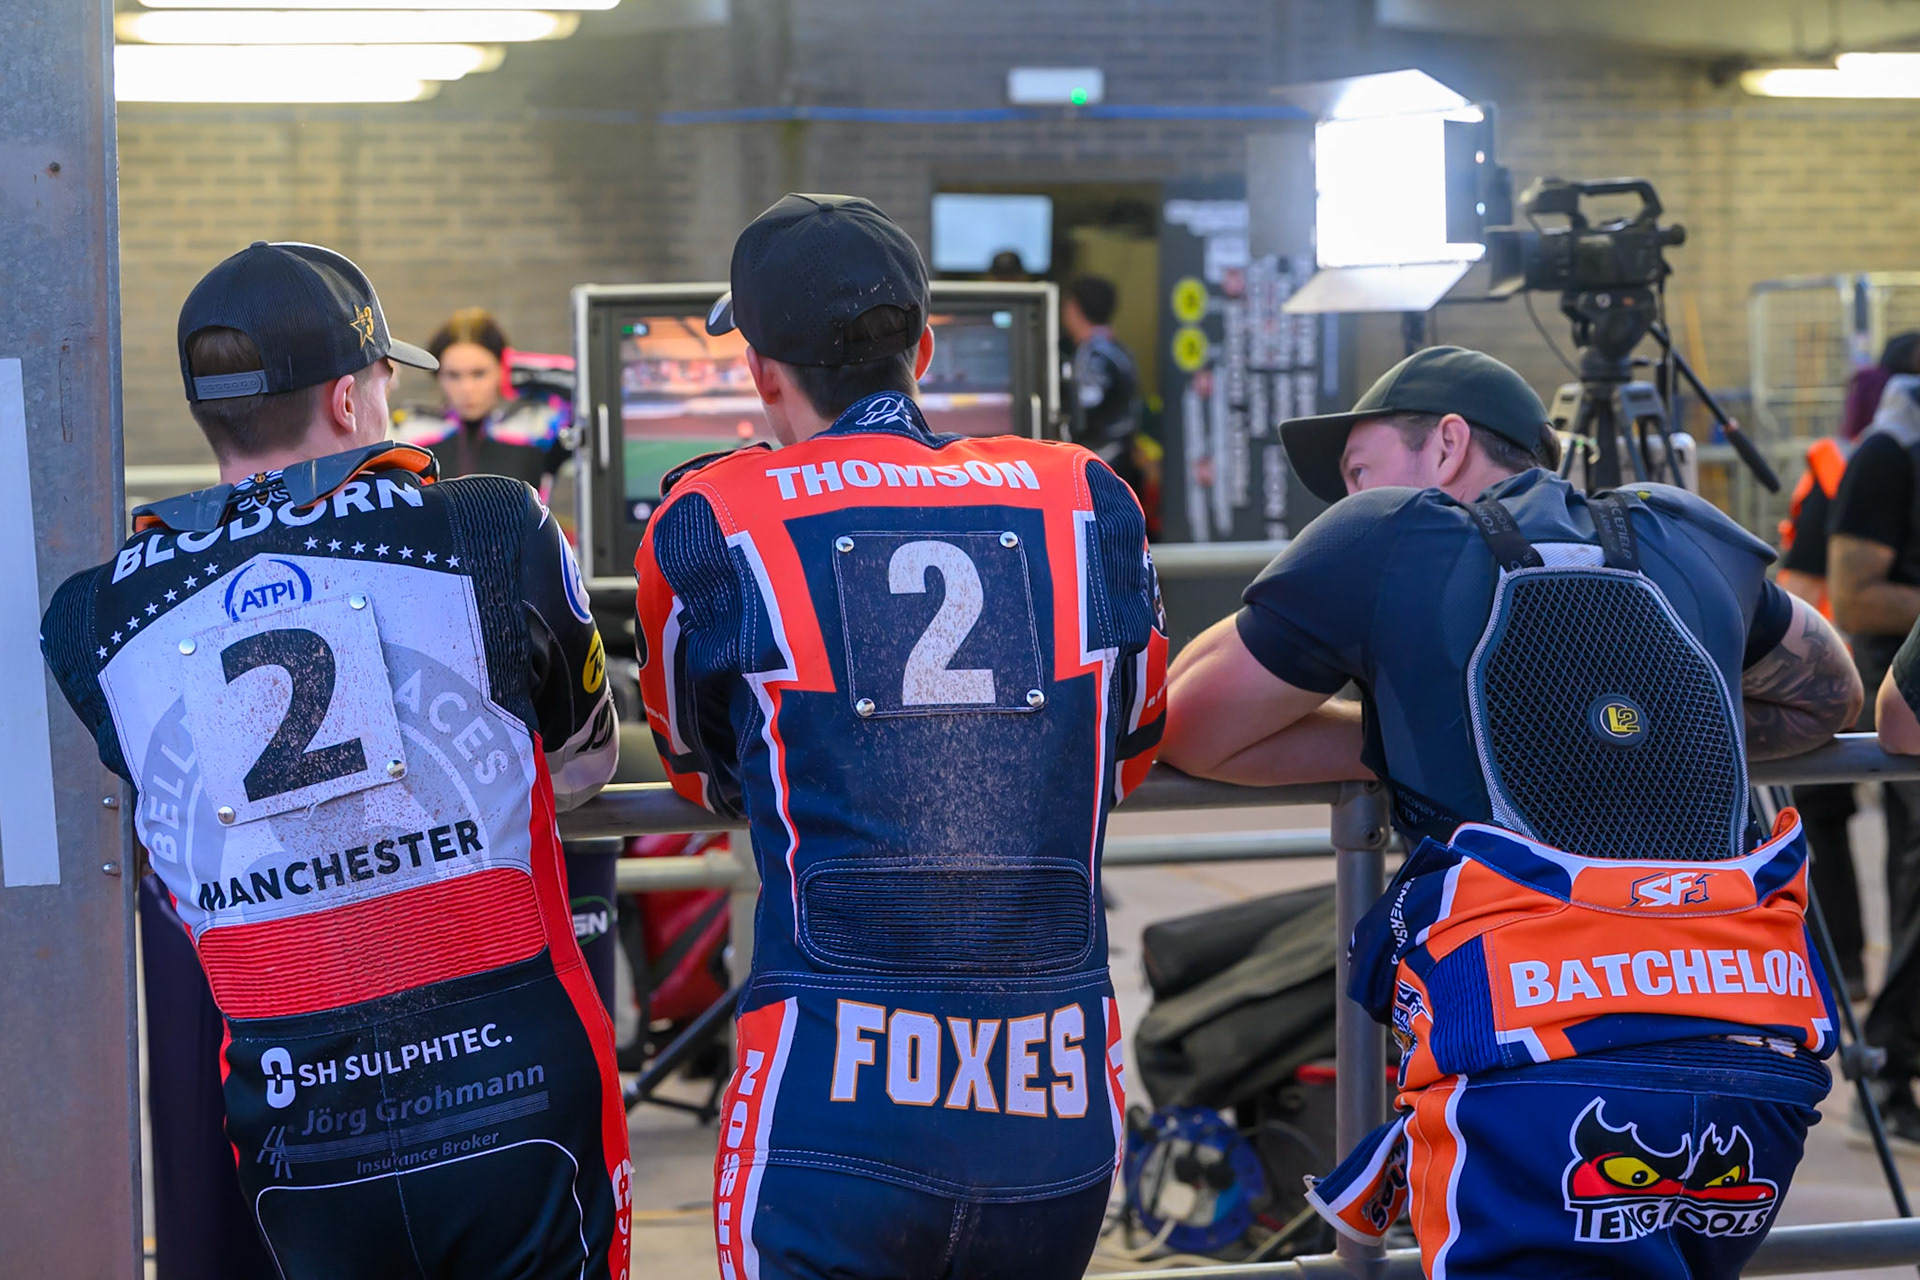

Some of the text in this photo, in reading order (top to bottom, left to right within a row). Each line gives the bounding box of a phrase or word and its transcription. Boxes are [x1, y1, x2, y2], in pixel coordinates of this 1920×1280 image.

[766, 460, 1040, 501] THOMSON
[240, 579, 297, 614] ATPI
[888, 539, 997, 707] 2
[220, 627, 369, 803] 2
[394, 668, 509, 786] ACES
[151, 742, 198, 864] BELL
[198, 818, 484, 912] MANCHESTER
[1509, 948, 1813, 1008] BATCHELOR
[298, 1058, 337, 1088] SH
[302, 1063, 546, 1136] Jörg Grohmann
[830, 998, 1089, 1119] FOXES
[356, 1130, 500, 1176] Insurance Broker
